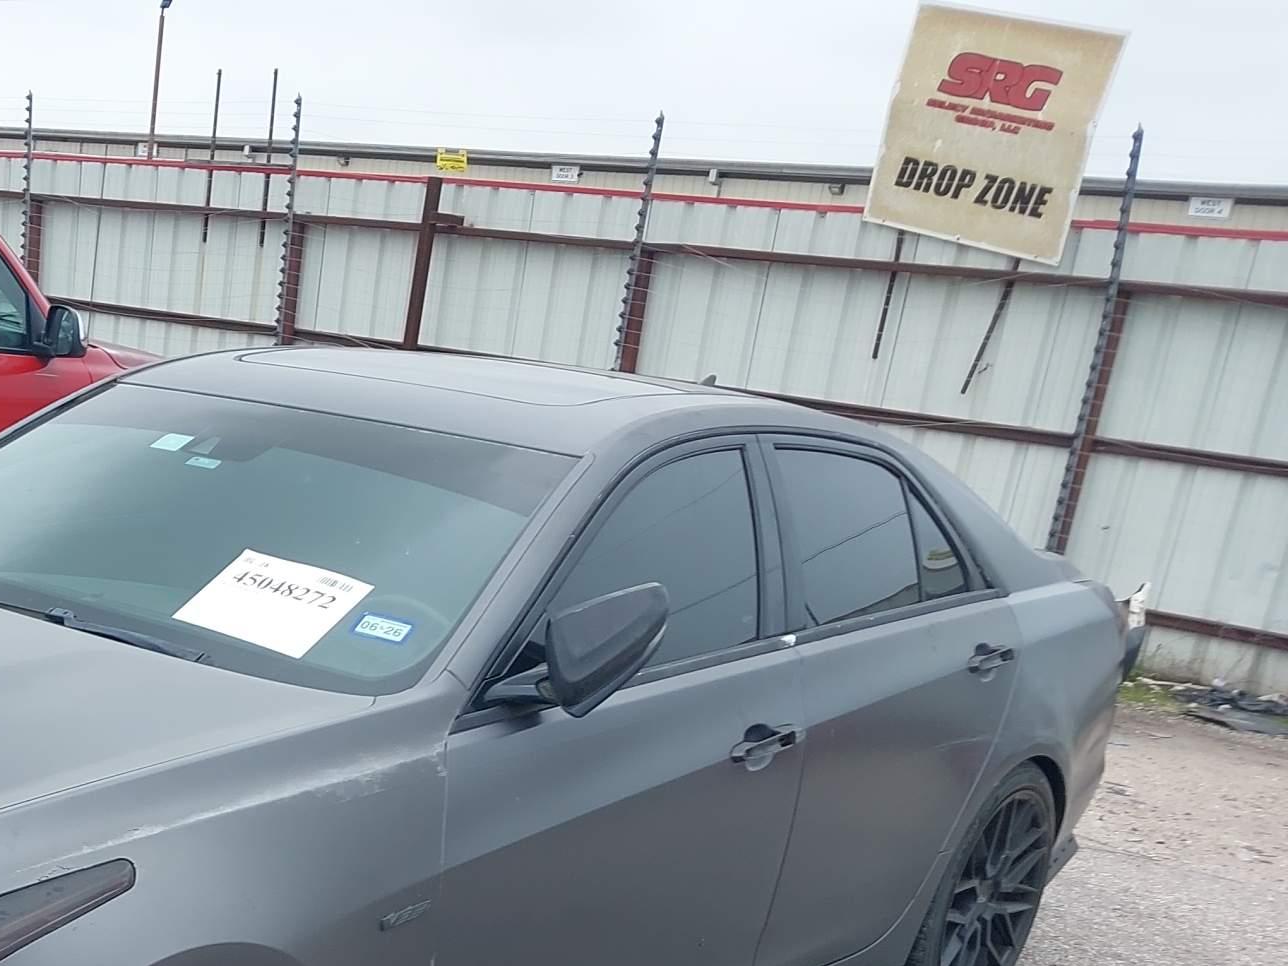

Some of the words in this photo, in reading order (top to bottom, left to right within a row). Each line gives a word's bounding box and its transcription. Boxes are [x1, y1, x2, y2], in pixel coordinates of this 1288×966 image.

[937, 52, 1063, 112] SRG
[894, 156, 977, 200] DROP
[973, 173, 1053, 219] ZONE
[233, 571, 337, 608] 45048272
